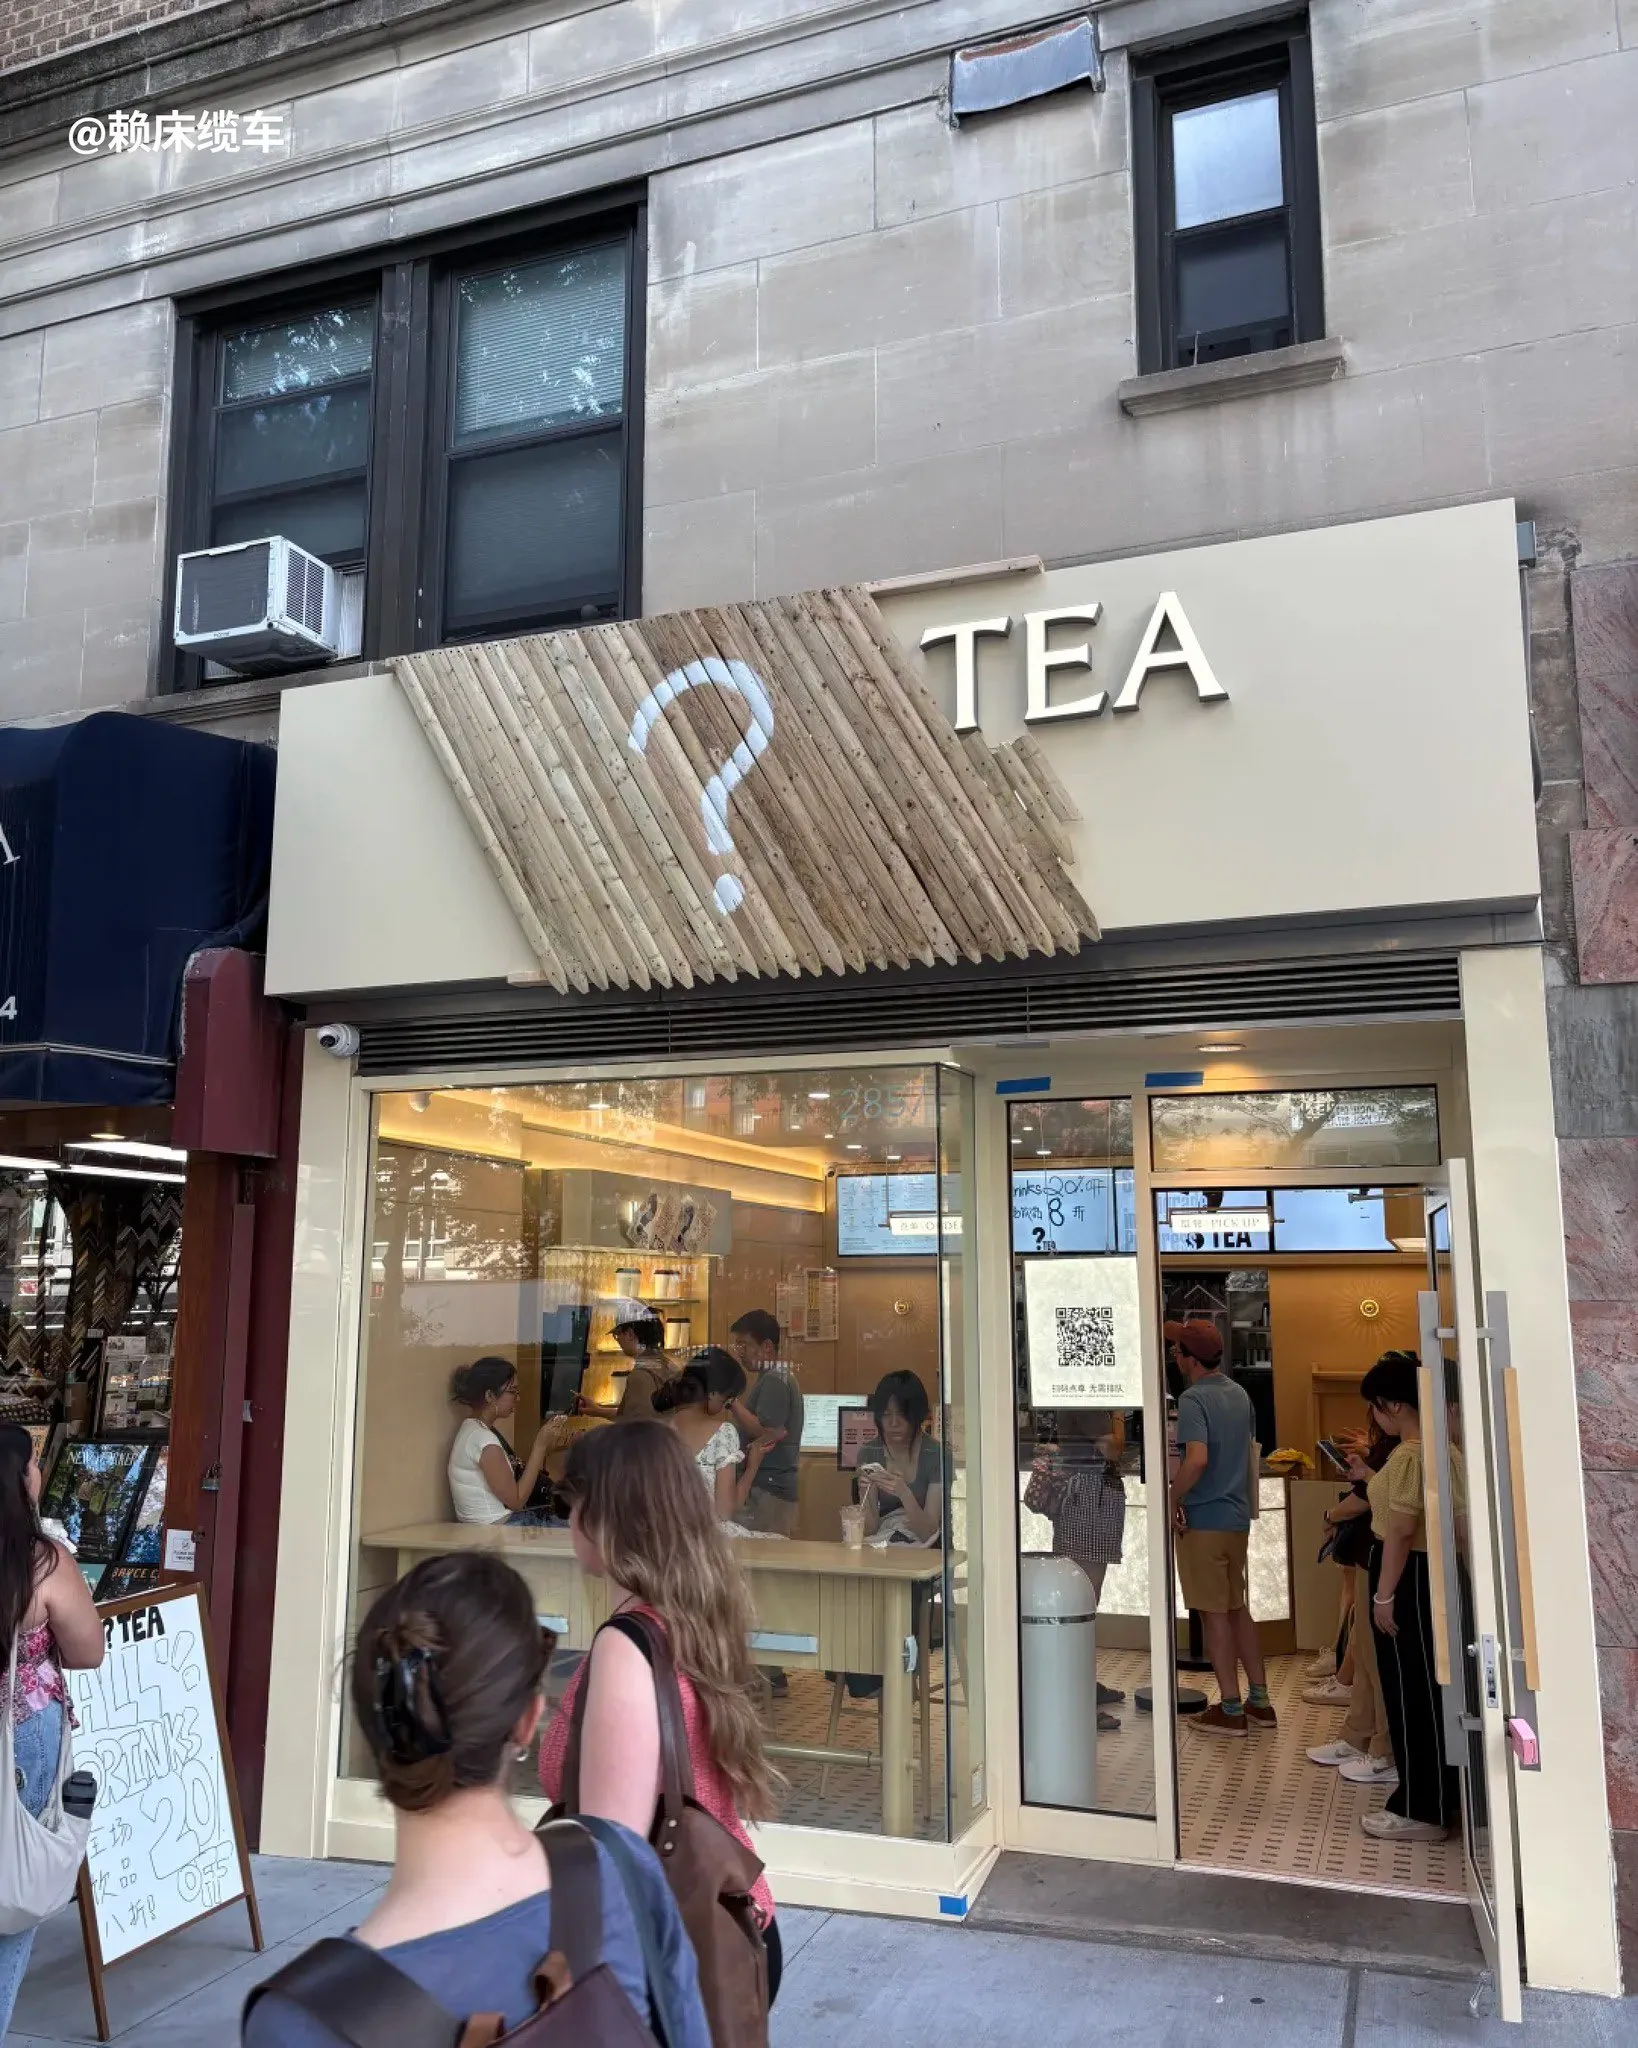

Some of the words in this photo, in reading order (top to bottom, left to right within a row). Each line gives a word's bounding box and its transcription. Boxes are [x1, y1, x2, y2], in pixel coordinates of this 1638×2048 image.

[919, 590, 1231, 734] TEA
[839, 1084, 926, 1120] 2857
[1048, 1197, 1065, 1227] 8
[1211, 1218, 1241, 1228] PICK
[1243, 1218, 1260, 1228] UP
[117, 1606, 165, 1643] TEA
[70, 1645, 163, 1738] ALL
[72, 1706, 202, 1811] DRINKS
[177, 1840, 234, 1907] OFF
